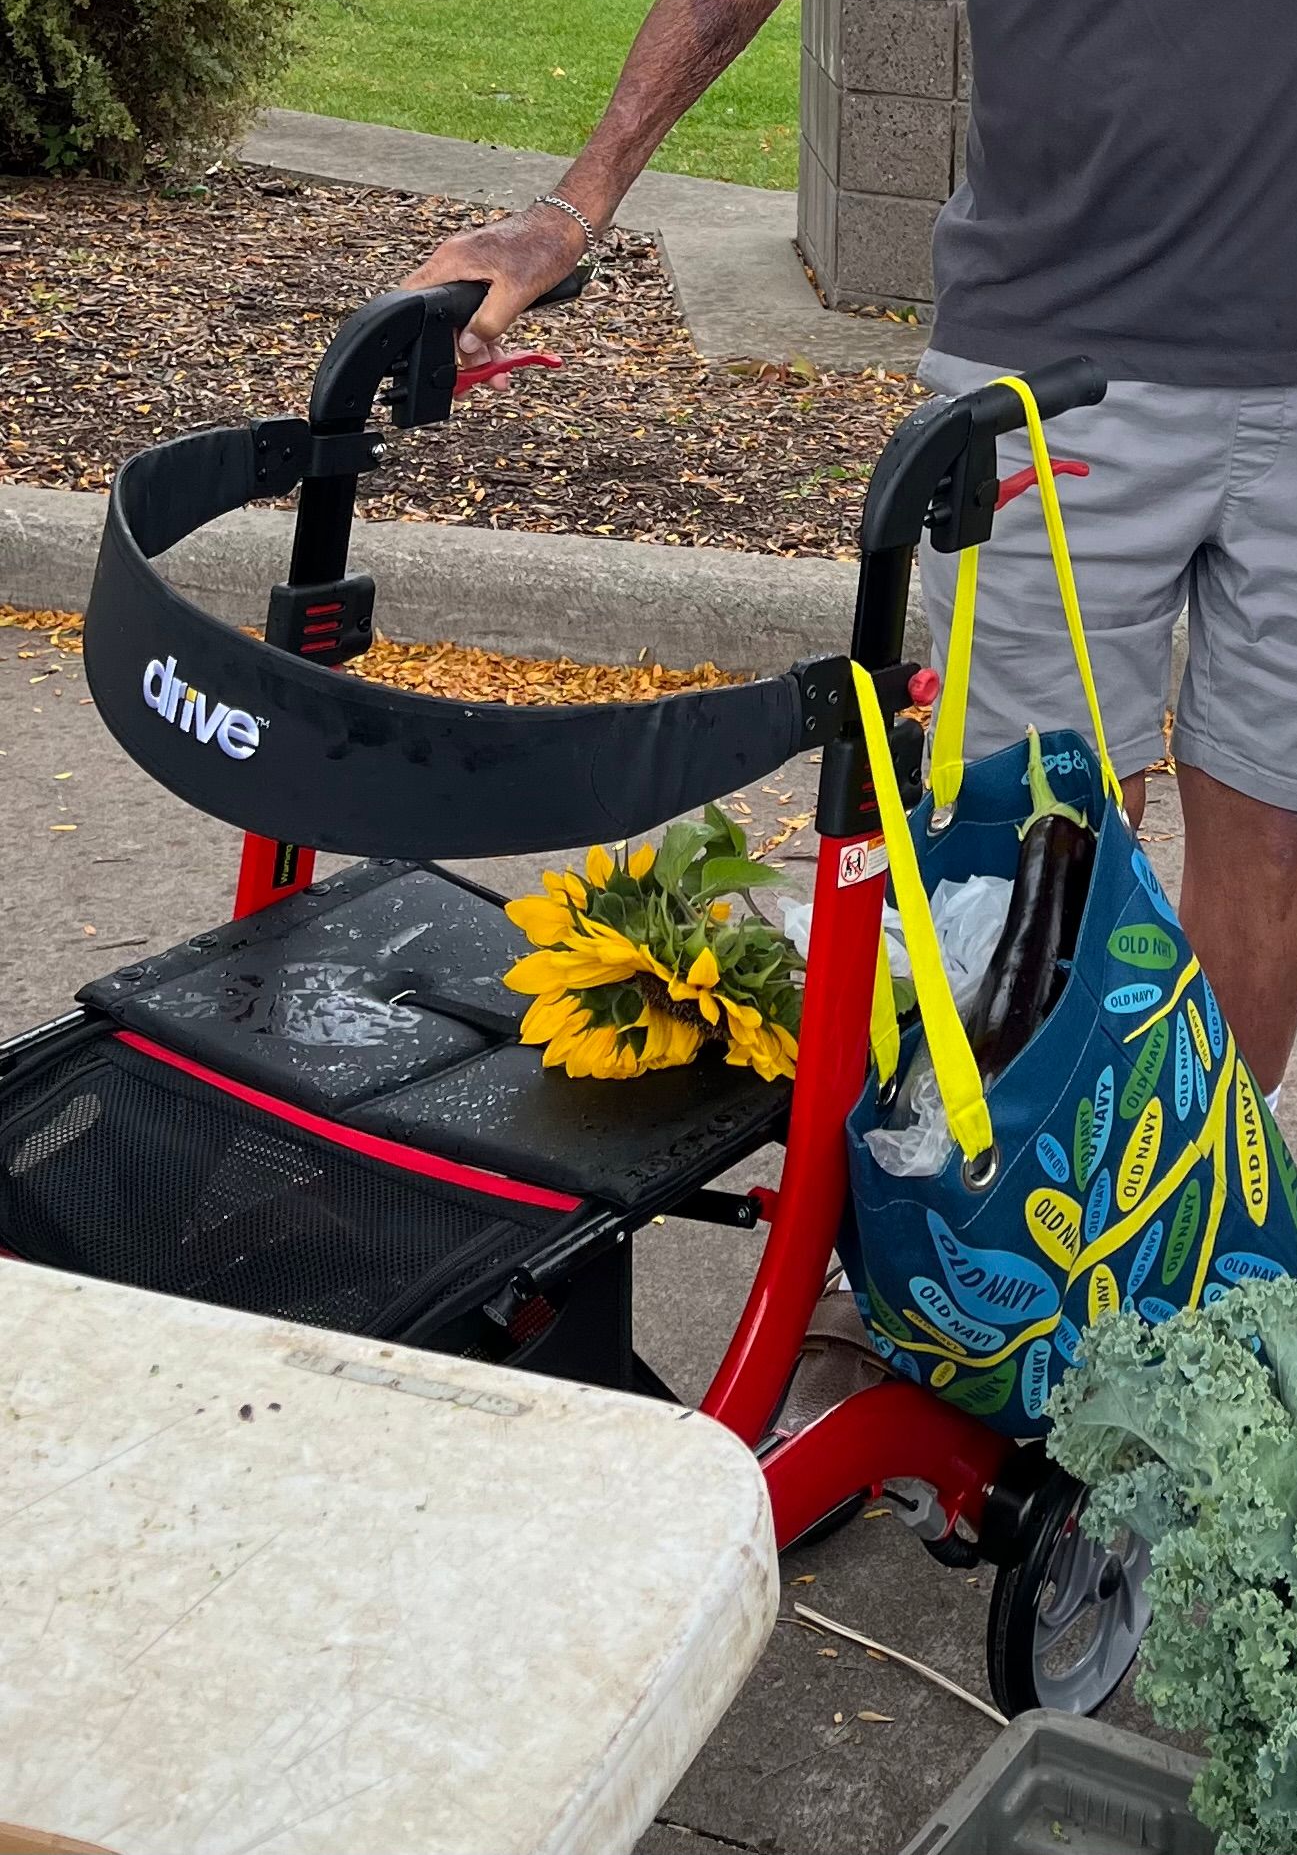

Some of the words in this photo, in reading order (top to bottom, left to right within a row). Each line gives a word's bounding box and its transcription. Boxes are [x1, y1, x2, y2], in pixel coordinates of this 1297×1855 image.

[1118, 935, 1149, 954] OLD
[1110, 993, 1131, 1009] OLD
[1132, 988, 1155, 1003] NAVY
[1178, 1025, 1188, 1070] NAVY
[1212, 1016, 1221, 1046] OLD
[1126, 1076, 1150, 1110] OLD
[1144, 1028, 1165, 1074] NAVY
[1179, 1074, 1188, 1107] OLD
[1080, 1110, 1091, 1148] NAVY
[1090, 1082, 1112, 1139] NAVY
[1239, 1079, 1257, 1147] NAVY
[1123, 1166, 1144, 1198] OLD
[1136, 1111, 1158, 1164] NAVY
[1092, 1177, 1108, 1206] NAVY
[1249, 1154, 1263, 1206] OLD
[1034, 1198, 1065, 1232] OLD
[1056, 1225, 1080, 1255] NA
[1089, 1206, 1101, 1234] OLD
[1174, 1194, 1197, 1240] NAVY
[939, 1233, 987, 1288] OLD
[977, 1274, 1047, 1313] NAVY
[1131, 1263, 1146, 1287] OLD
[1140, 1229, 1159, 1262] NAVY
[1167, 1240, 1185, 1273] OLD
[1223, 1257, 1250, 1275] OLD
[1250, 1265, 1282, 1281] NAV
[920, 1285, 951, 1318] OLD
[948, 1320, 998, 1347] NAVY
[1032, 1350, 1047, 1385] NAVY
